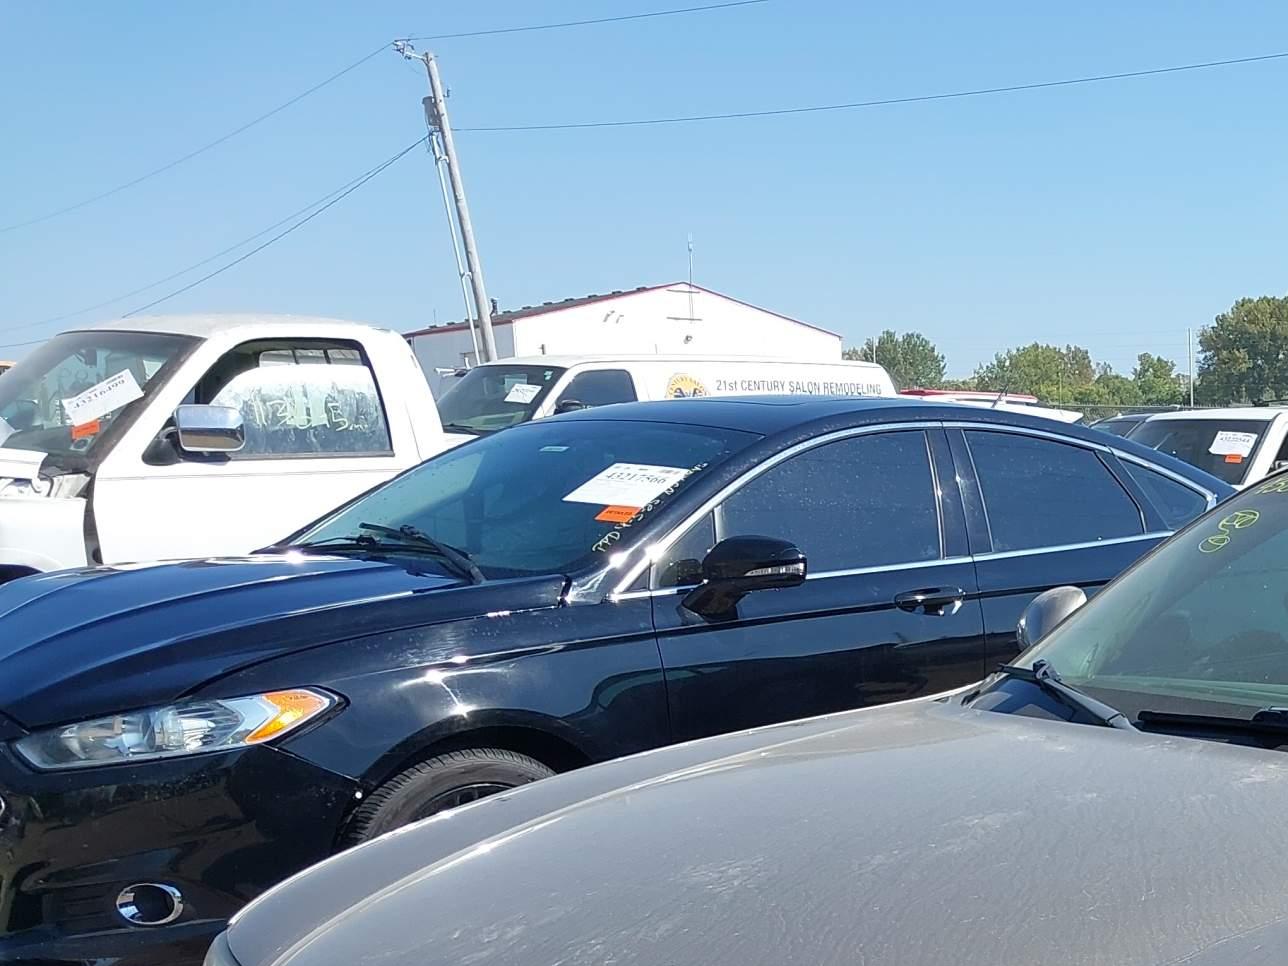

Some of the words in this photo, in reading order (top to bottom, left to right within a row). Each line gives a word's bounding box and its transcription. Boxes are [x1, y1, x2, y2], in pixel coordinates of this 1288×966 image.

[716, 379, 738, 391] 21st
[741, 379, 786, 392] CENTURY
[789, 380, 820, 394] SALON
[823, 381, 882, 395] REMODELING
